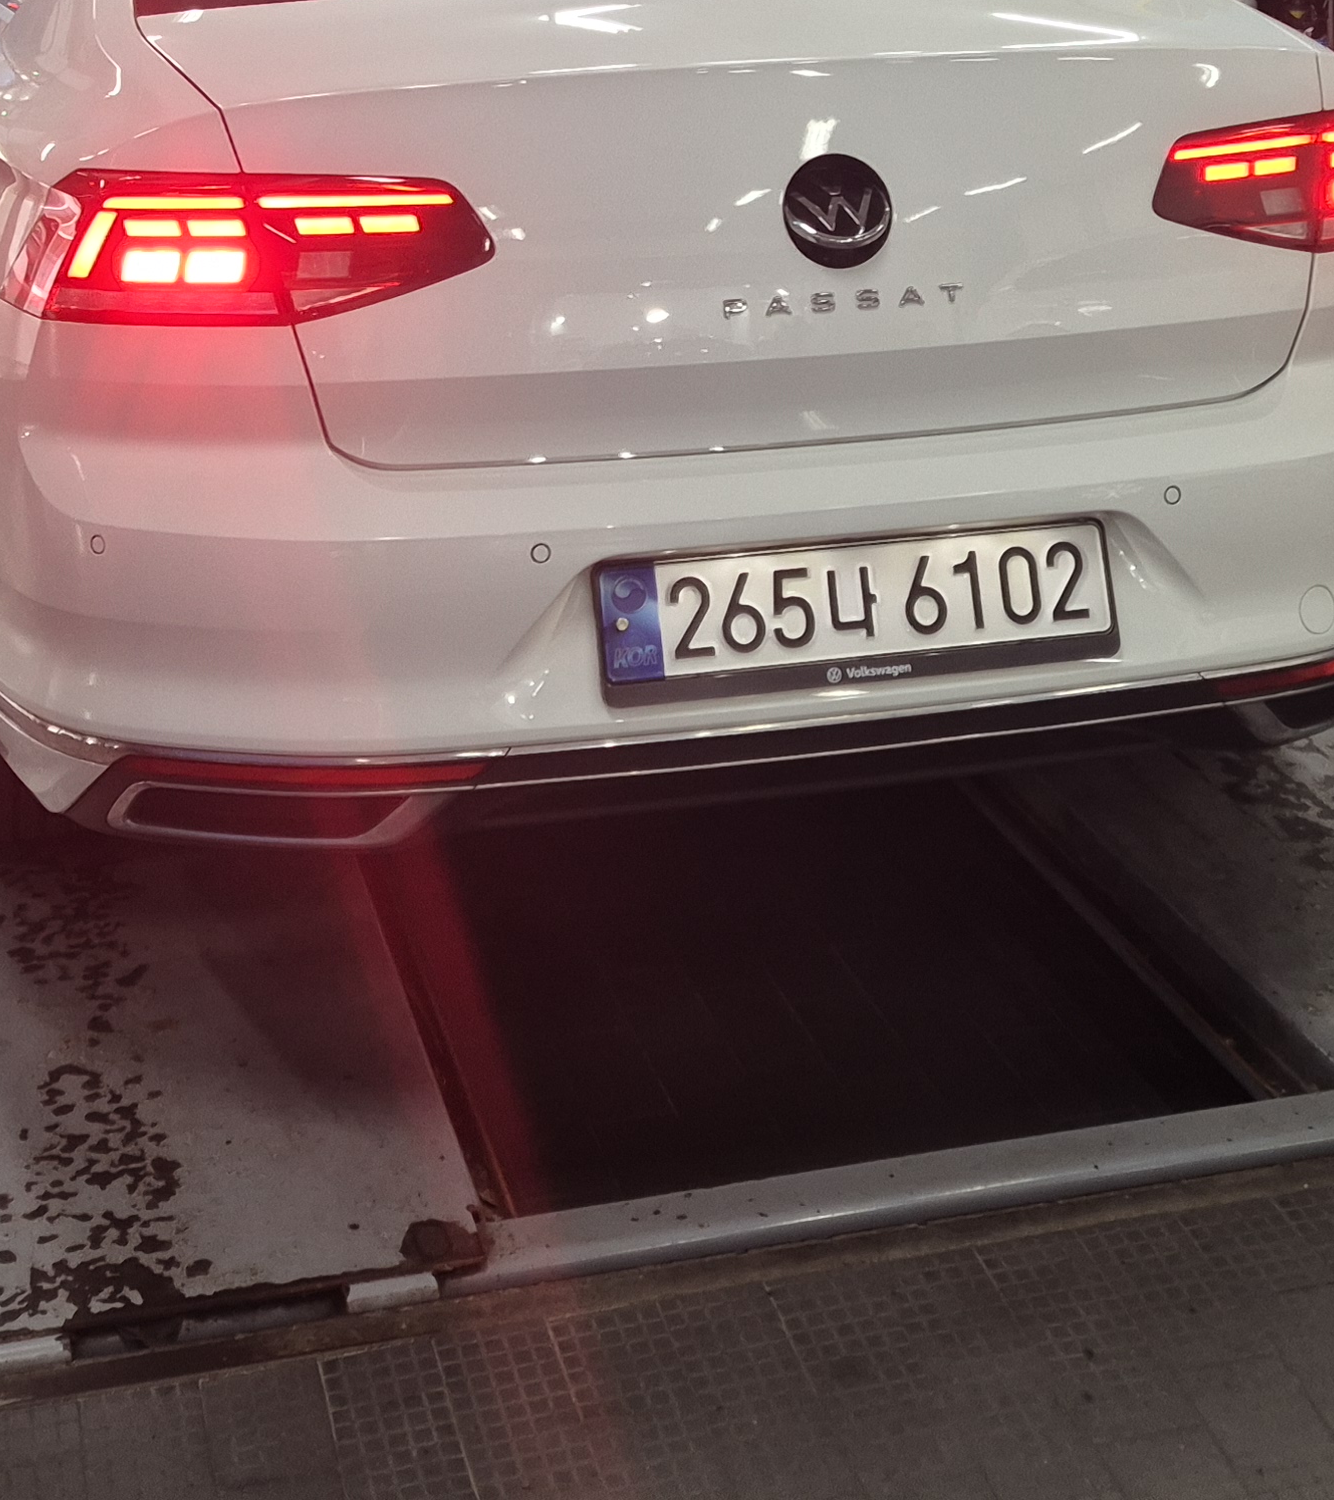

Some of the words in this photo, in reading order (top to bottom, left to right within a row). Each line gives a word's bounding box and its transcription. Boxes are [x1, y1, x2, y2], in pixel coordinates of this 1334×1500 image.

[722, 282, 964, 320] PASSAT
[669, 565, 878, 660] 265나
[904, 541, 1091, 636] 6102
[612, 644, 658, 669] KOR
[846, 663, 912, 679] Volkswagen
